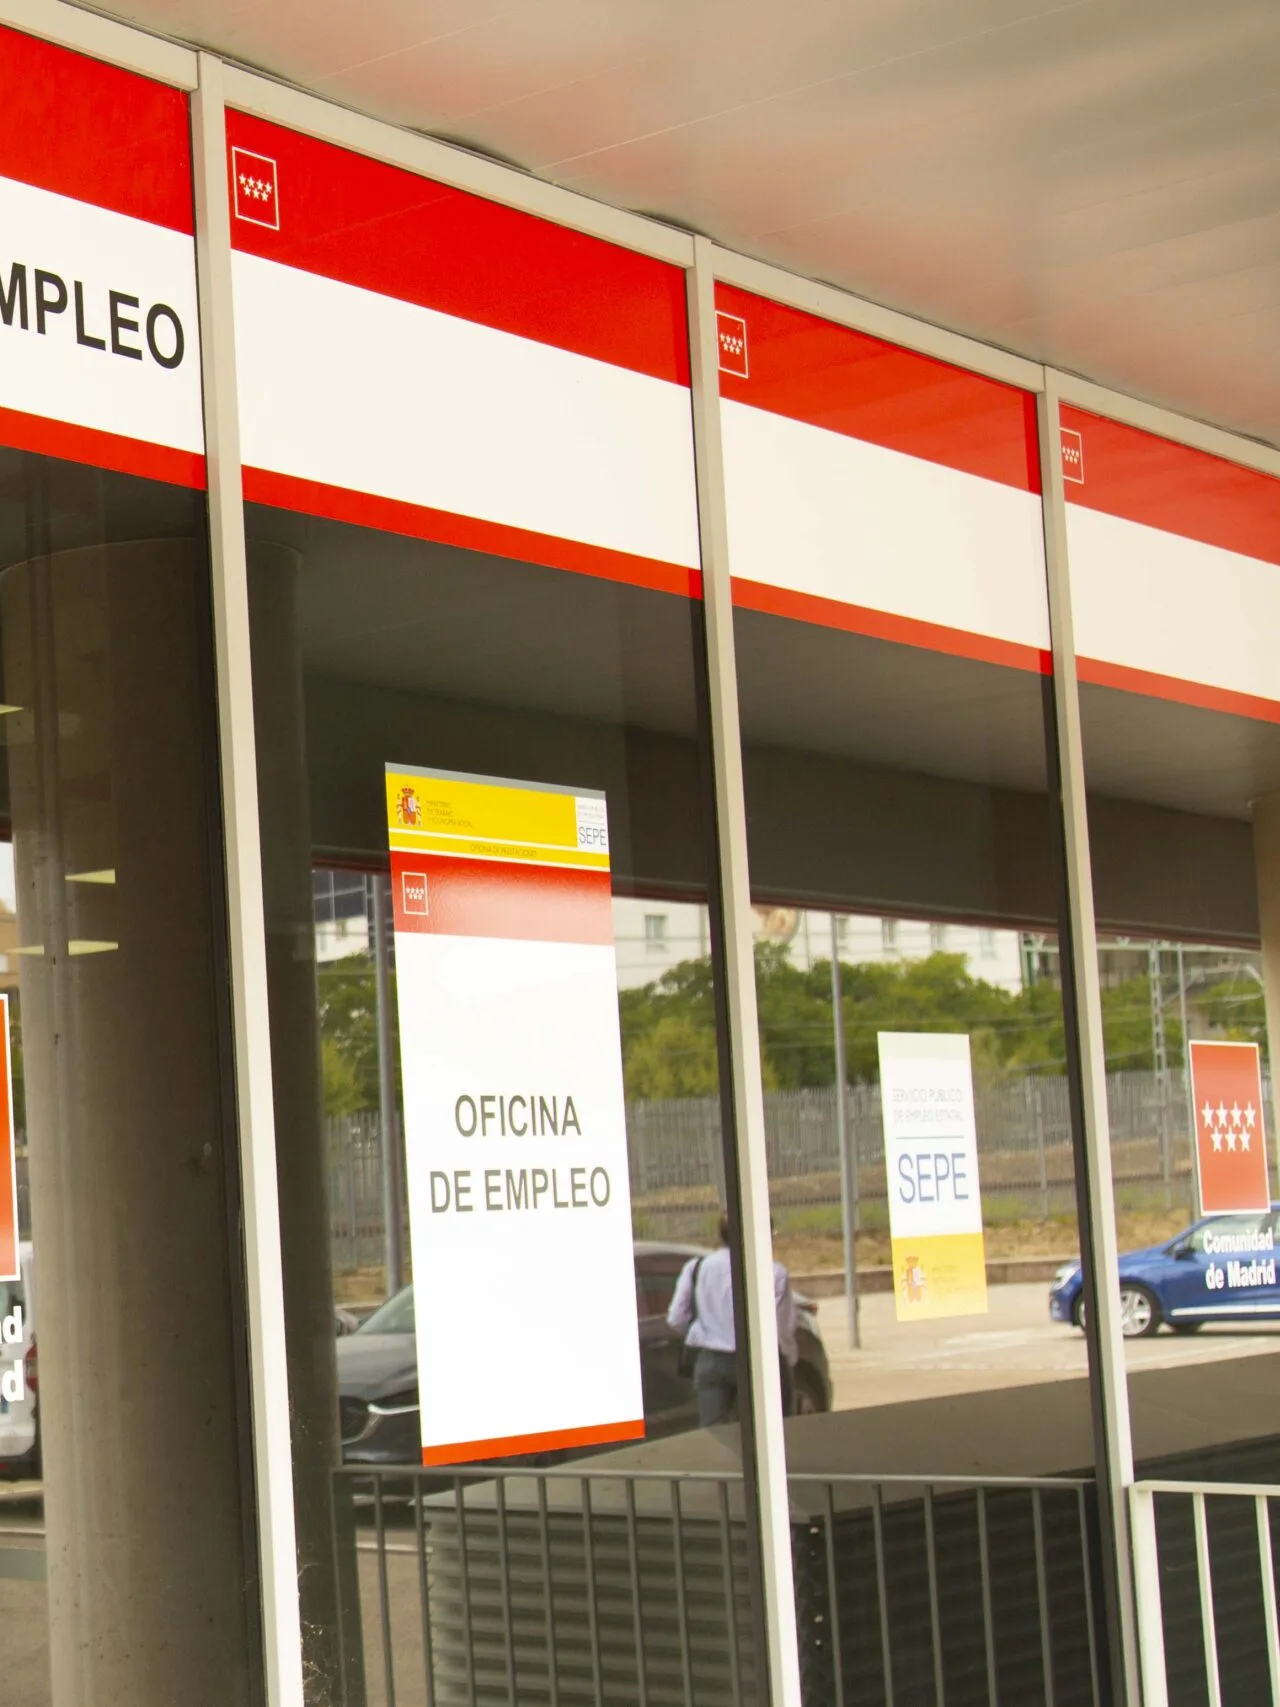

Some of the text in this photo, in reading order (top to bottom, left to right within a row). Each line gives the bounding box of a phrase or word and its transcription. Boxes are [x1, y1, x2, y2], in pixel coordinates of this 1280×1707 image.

[578, 826, 607, 846] SEPE
[454, 1094, 582, 1138] OFICINA
[429, 1166, 610, 1214] DE EMPLEO
[898, 1153, 969, 1204] SEPE
[1202, 1226, 1274, 1255] Comunidad
[1205, 1257, 1276, 1290] de Madrid
